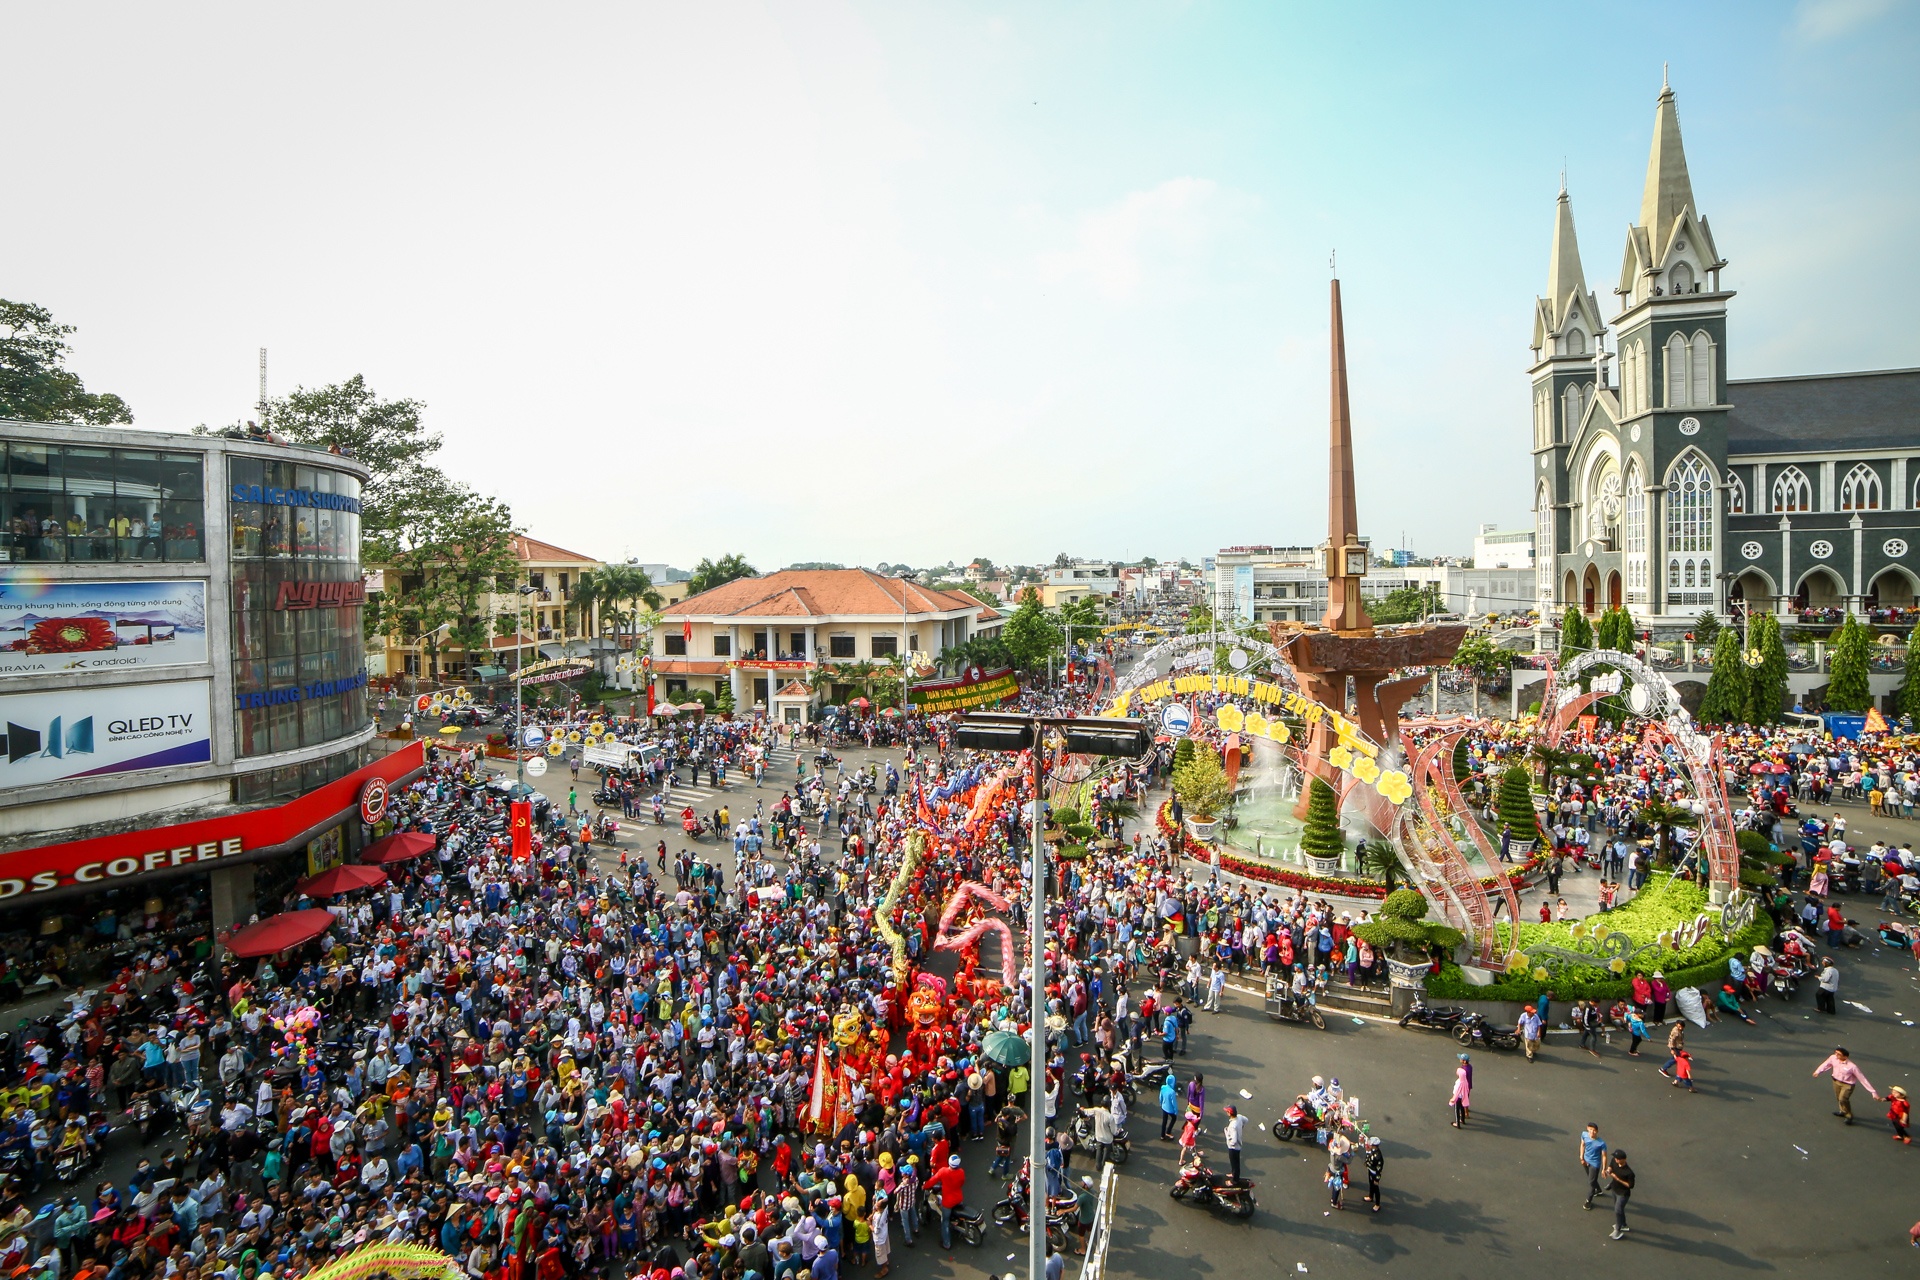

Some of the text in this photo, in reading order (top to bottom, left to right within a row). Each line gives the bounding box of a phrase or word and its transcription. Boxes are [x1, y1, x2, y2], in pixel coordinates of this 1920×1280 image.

[232, 483, 309, 507] SAIGON
[236, 687, 300, 710] TRUNG
[305, 680, 335, 699] TÂM
[1140, 673, 1324, 724] CHÚC MỪNG NĂM MỚI 2018
[107, 713, 192, 734] QLED TV
[74, 837, 242, 882] COFFEE
